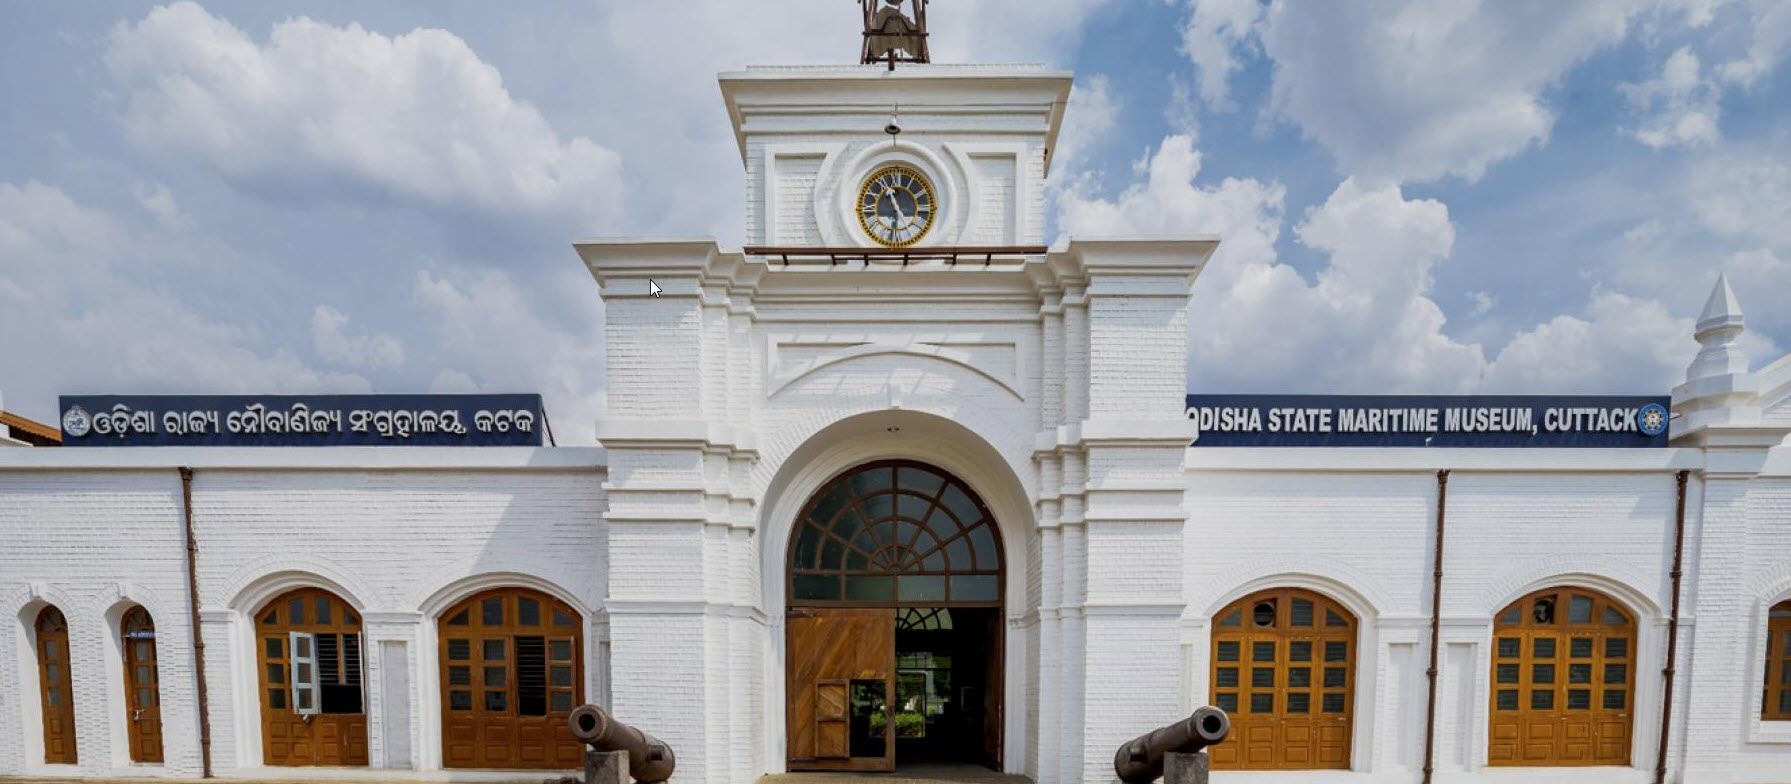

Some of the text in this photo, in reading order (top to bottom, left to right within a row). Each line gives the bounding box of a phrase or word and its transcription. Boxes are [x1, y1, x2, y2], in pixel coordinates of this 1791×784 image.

[92, 403, 155, 438] ଓଡ଼ିଶା
[163, 410, 219, 435] ରାଜ୍ୟ
[226, 403, 342, 433] ନୌବାଣିଜ୍ୟ
[474, 410, 534, 432] କଟକ
[1268, 407, 1332, 432] STATE
[1338, 408, 1438, 432] MARITIME
[1444, 407, 1537, 435] MUSEUM,
[1544, 407, 1639, 432] CUTTACK
